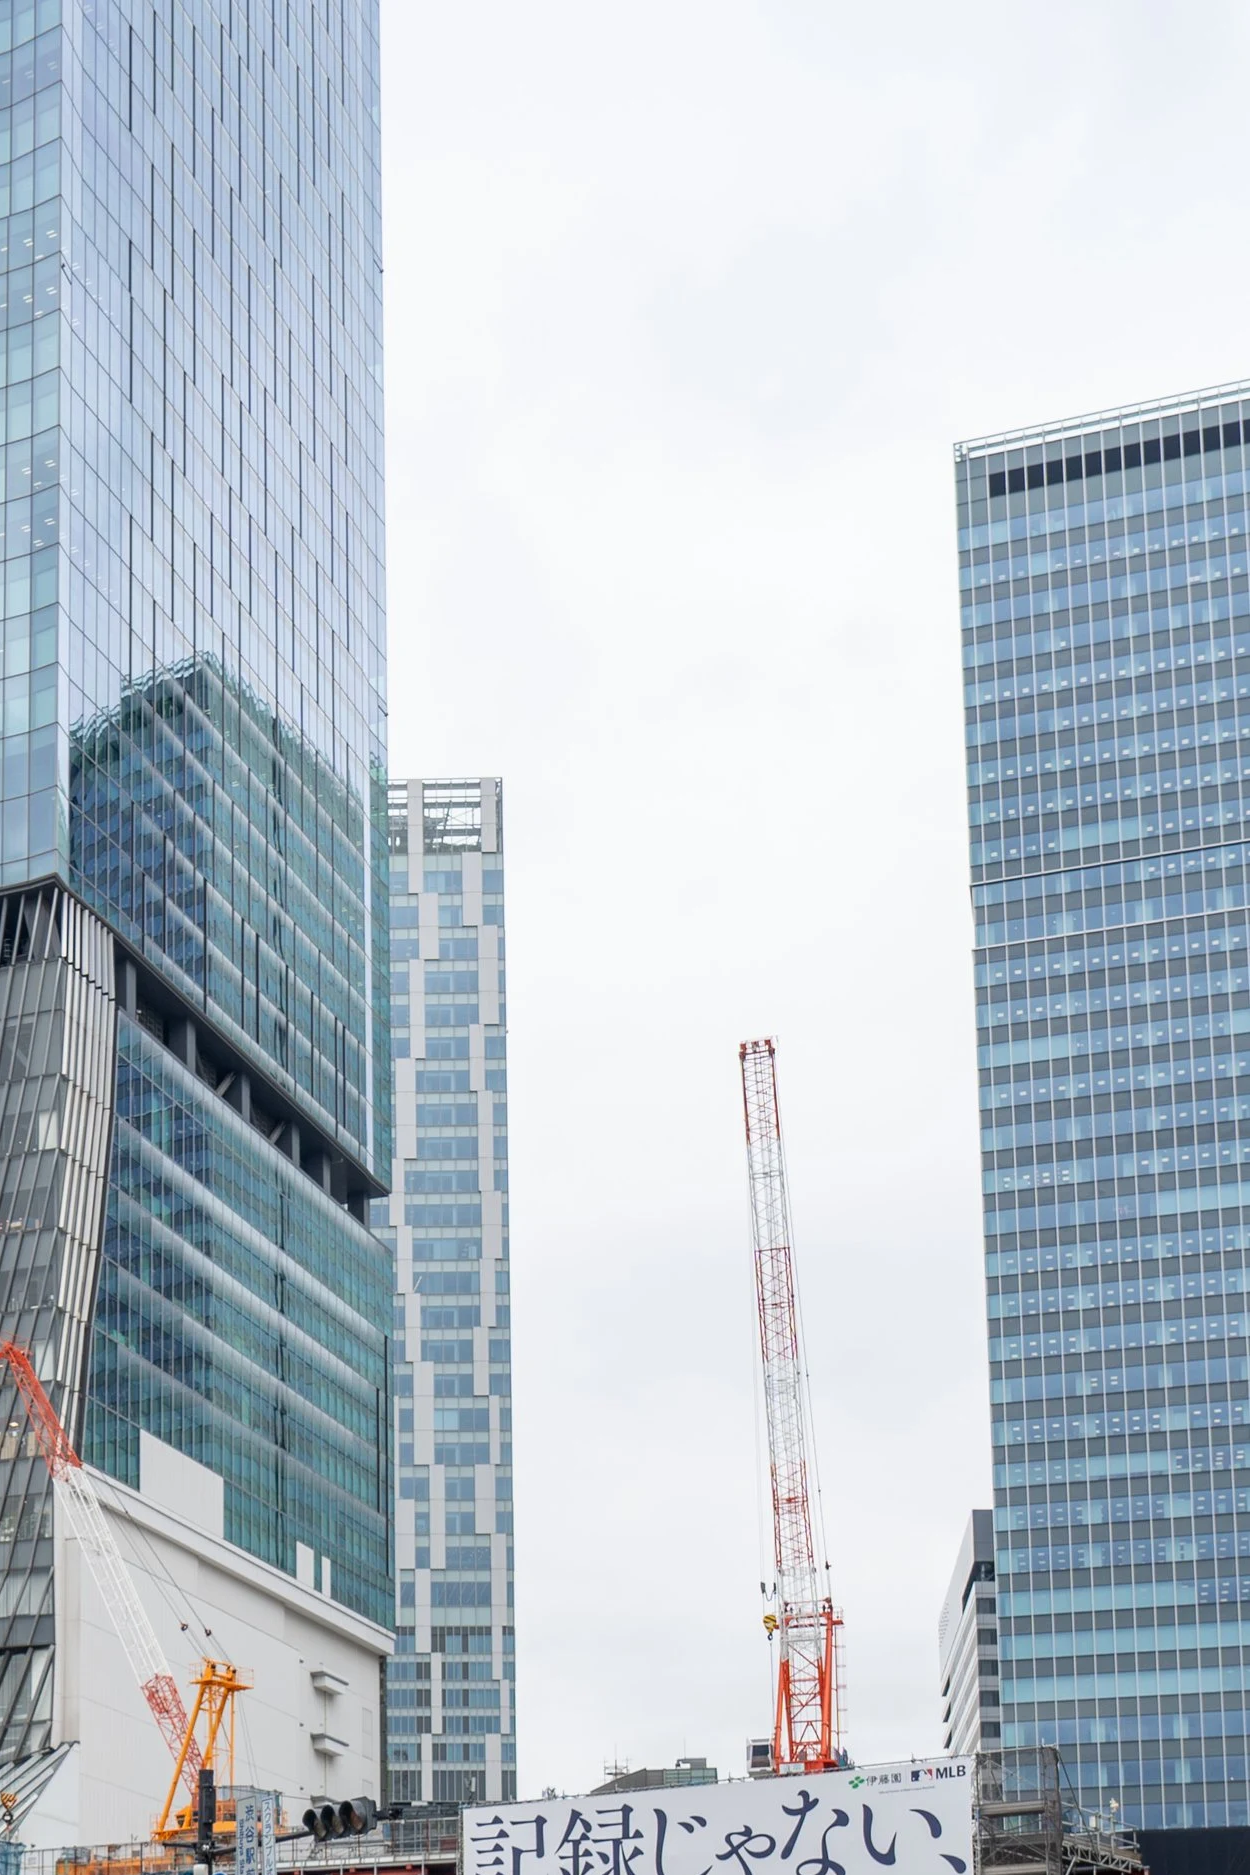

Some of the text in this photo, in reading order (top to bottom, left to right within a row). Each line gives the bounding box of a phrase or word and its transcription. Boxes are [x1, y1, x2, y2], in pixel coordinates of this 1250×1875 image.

[866, 1772, 902, 1787] 伊藤園
[935, 1764, 966, 1780] MLB
